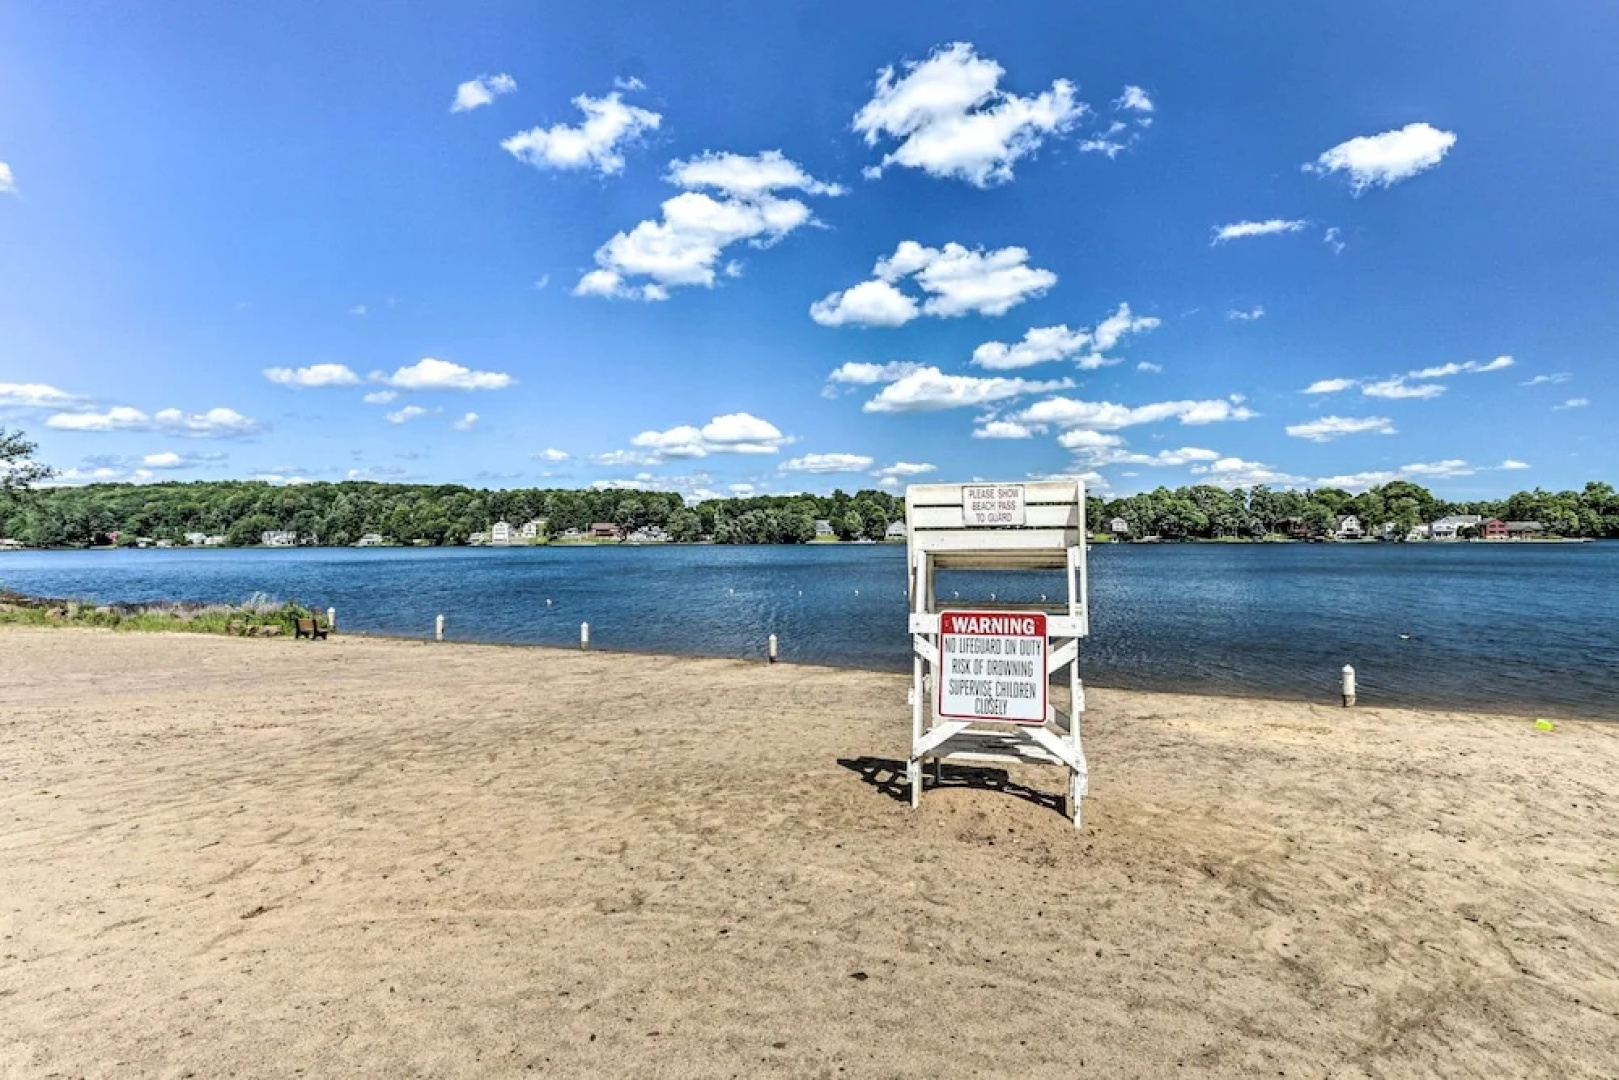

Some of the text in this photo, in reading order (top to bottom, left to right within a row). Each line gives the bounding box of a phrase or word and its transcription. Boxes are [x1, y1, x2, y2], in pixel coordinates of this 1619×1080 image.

[968, 489, 1019, 499] PLEASE SHOW
[972, 501, 1016, 511] BEACH PASS
[976, 513, 1012, 522] TO GUARD
[951, 617, 1035, 635] WARNING
[945, 637, 1041, 656] NO LIFEGUARD ON DUTY
[951, 659, 1033, 677] RISK OF DROWNING
[948, 679, 1036, 699] SUPERVISE CHILDREN
[974, 698, 1008, 715] CLOSELY
